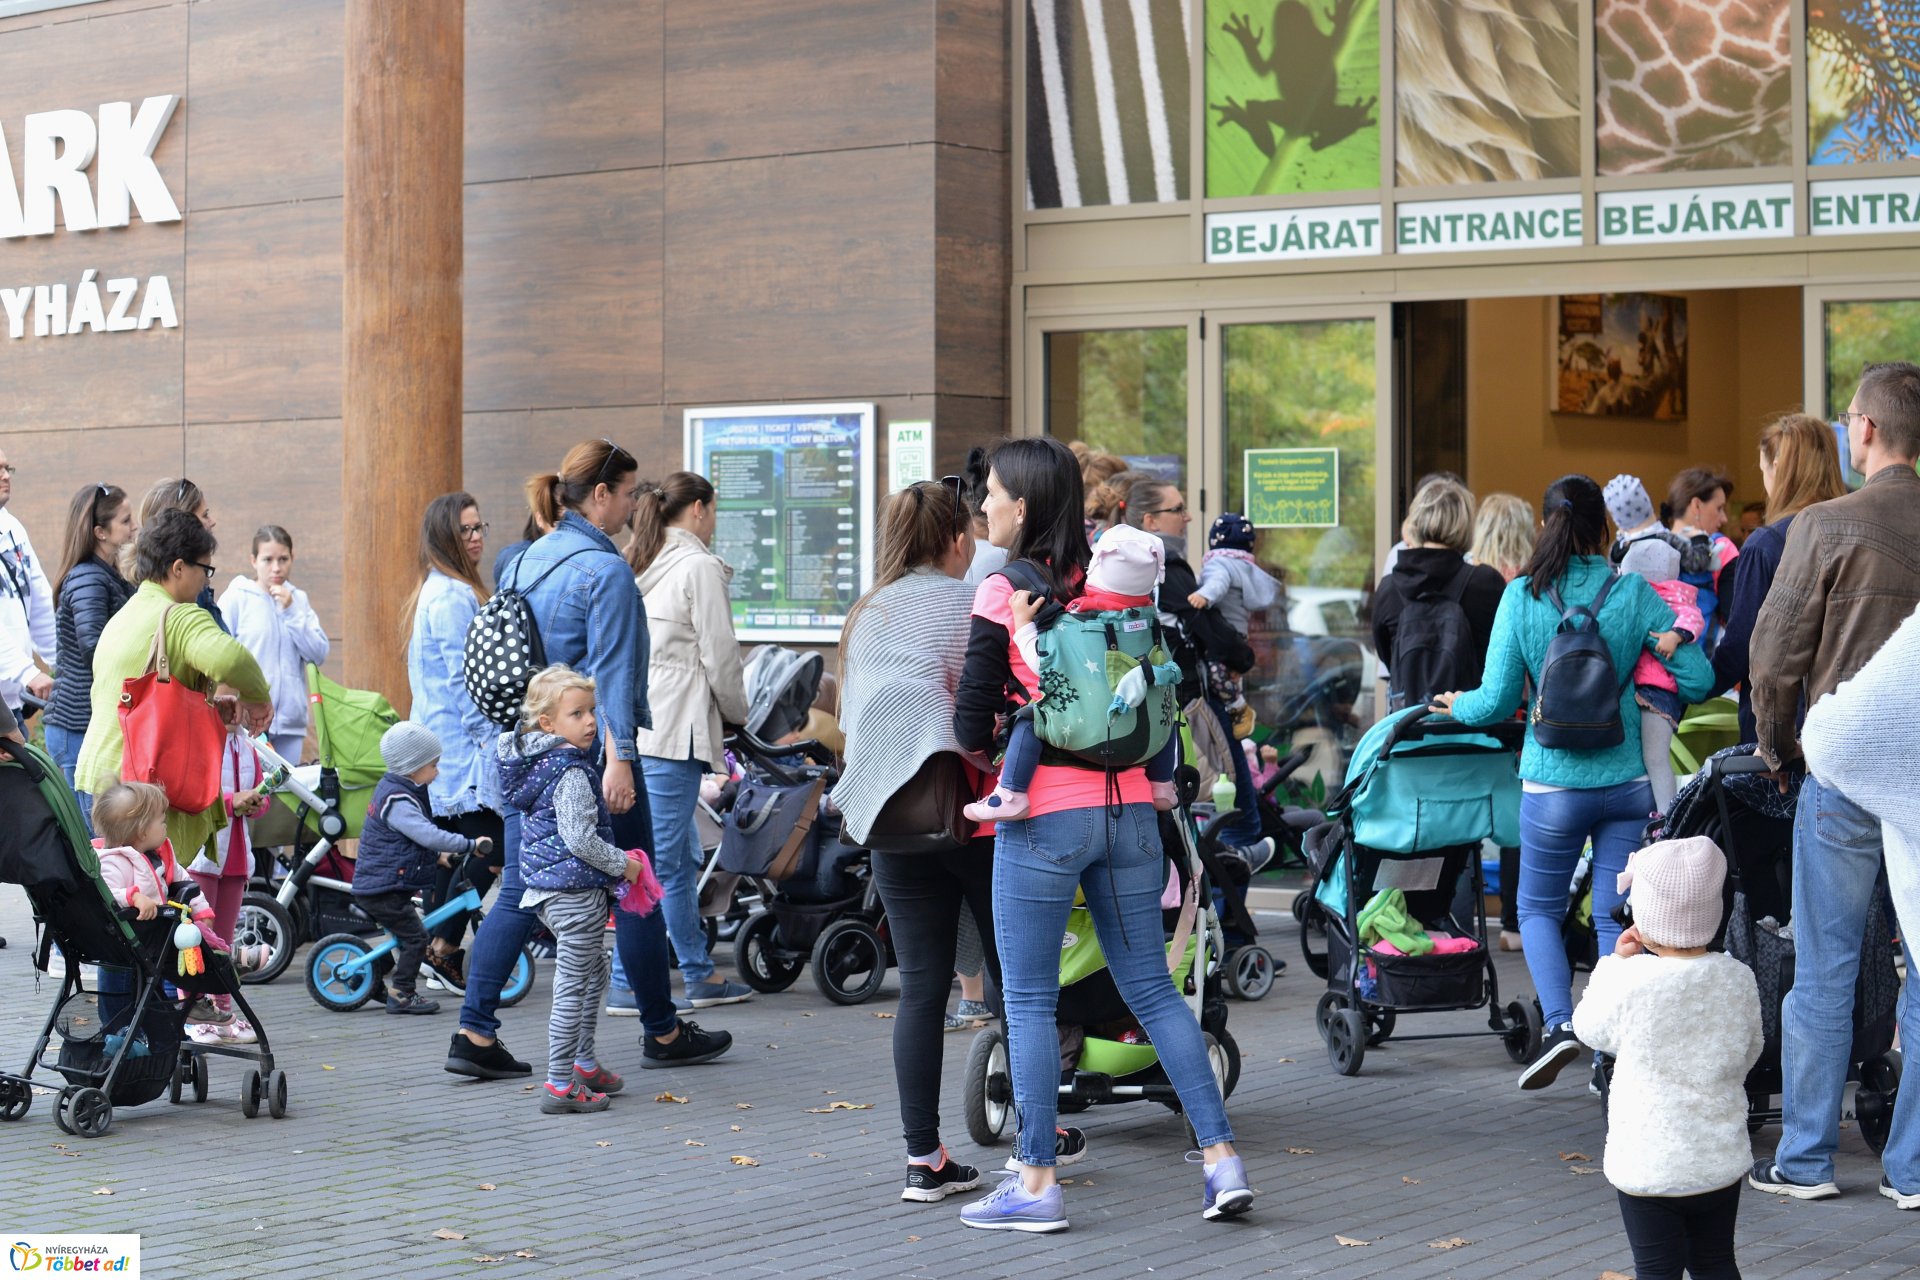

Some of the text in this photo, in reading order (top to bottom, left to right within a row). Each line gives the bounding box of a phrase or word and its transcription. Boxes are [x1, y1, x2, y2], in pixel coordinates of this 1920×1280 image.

[1399, 208, 1582, 245] ENTRANCE
[1603, 194, 1791, 236] BEJÁRAT
[1812, 192, 1920, 226] ENTR
[1210, 216, 1380, 255] BEJÁRAT
[0, 268, 179, 338] YHÁZA
[764, 423, 791, 432] TICKET
[897, 430, 922, 442] ATM
